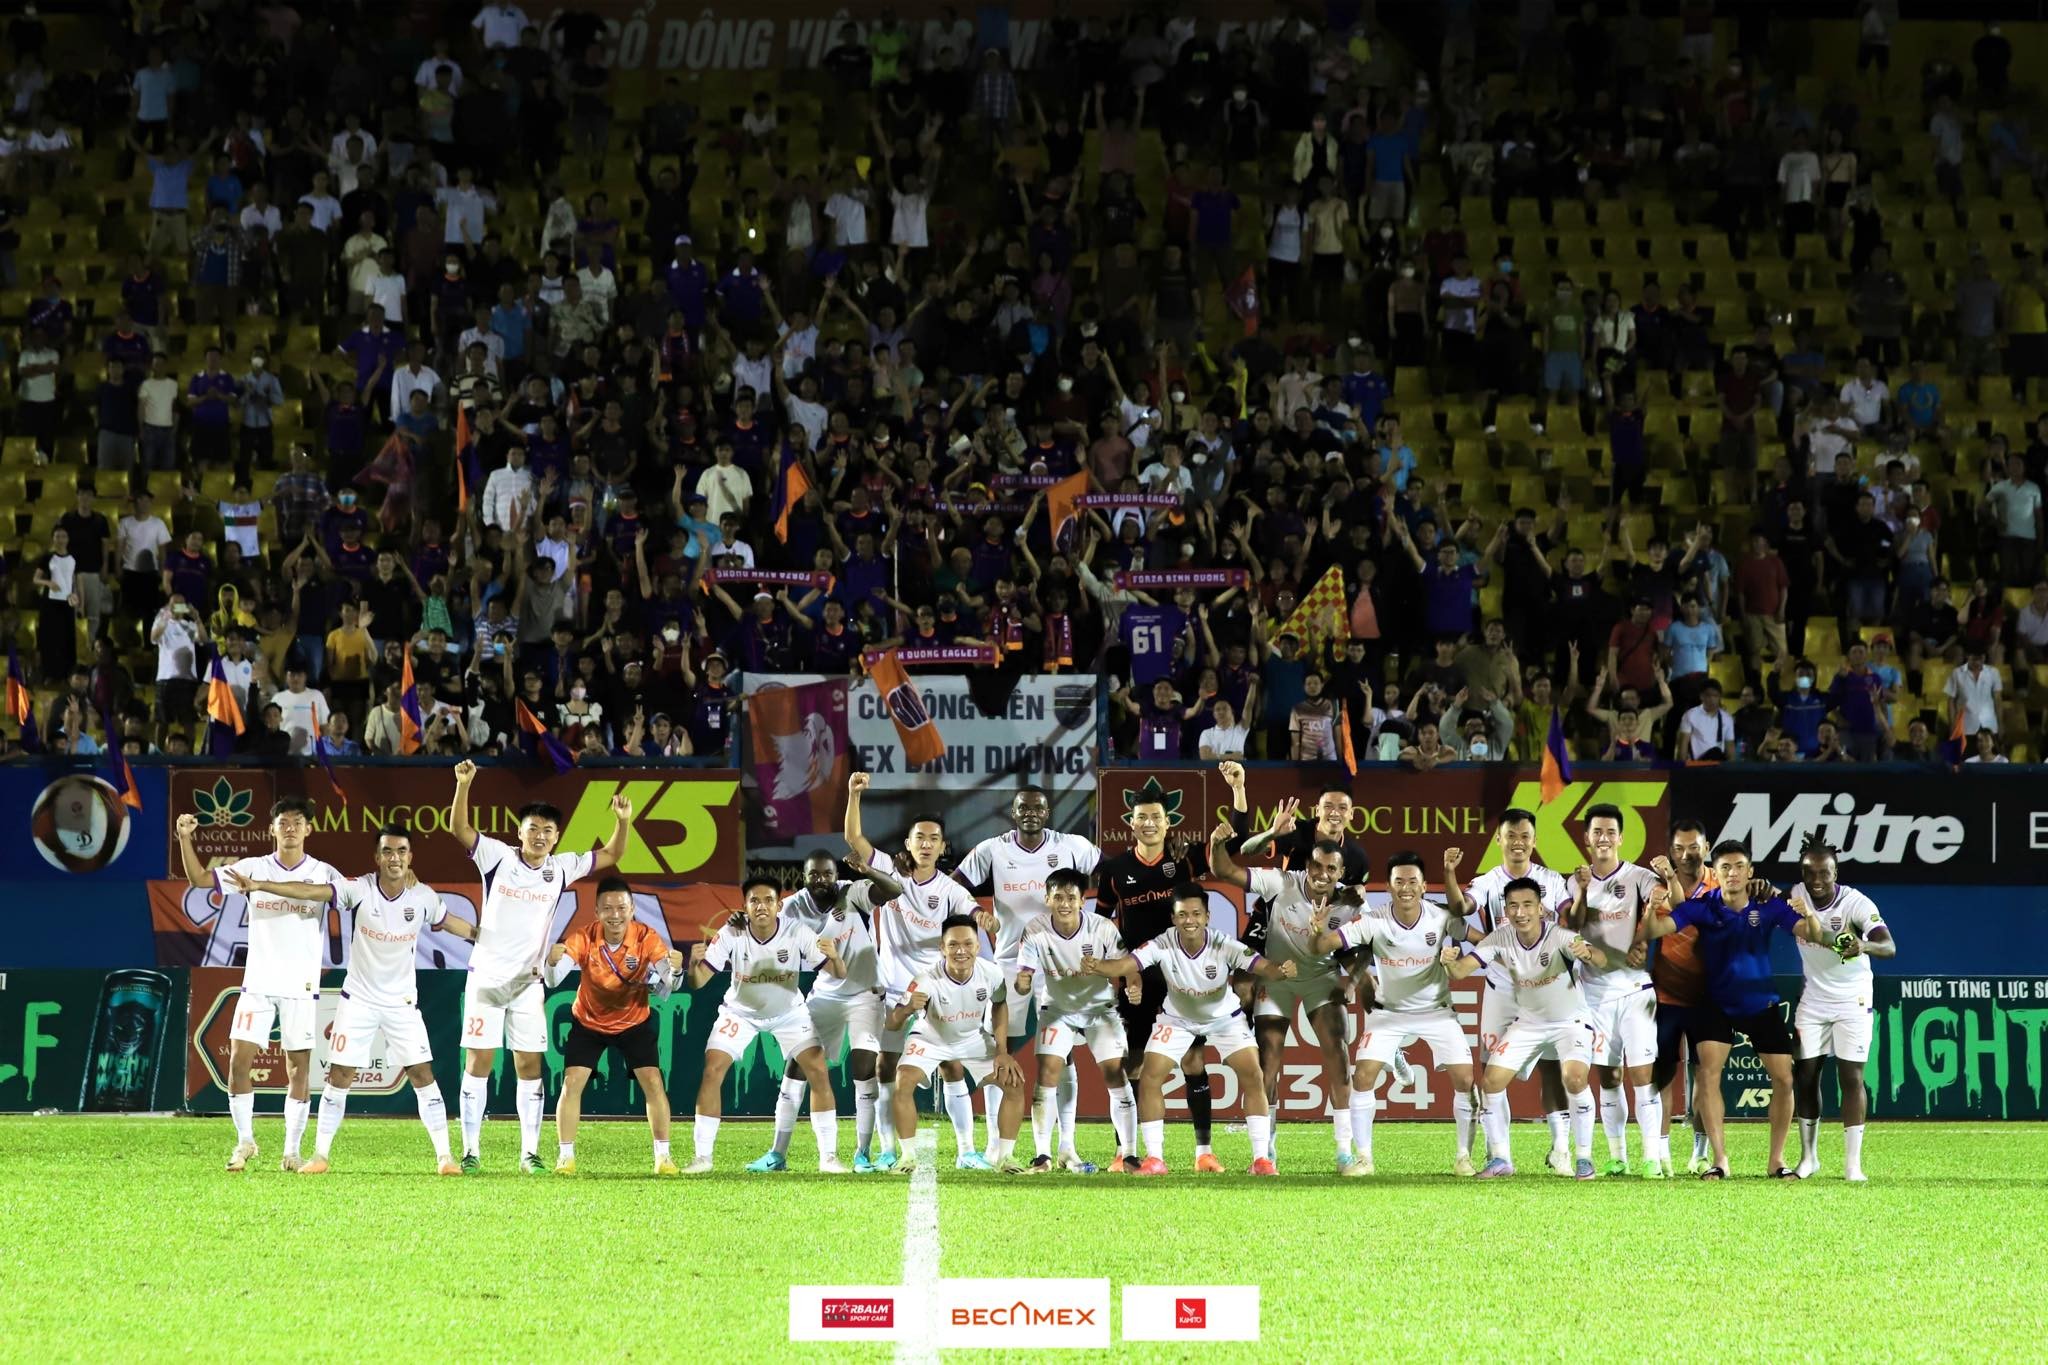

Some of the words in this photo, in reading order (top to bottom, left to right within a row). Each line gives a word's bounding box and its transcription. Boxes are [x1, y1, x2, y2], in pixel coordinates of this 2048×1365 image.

[1132, 574, 1163, 584] FORZA
[1166, 573, 1191, 583] BINH
[1193, 572, 1226, 582] DUONG
[1132, 625, 1162, 654] 61
[907, 649, 939, 659] DUONG
[942, 647, 979, 658] EAGLES
[473, 804, 523, 833] LIN
[554, 780, 739, 874] K5
[1403, 806, 1486, 835] LINH
[1705, 792, 1965, 864] Mitre
[173, 831, 199, 842] SM
[197, 845, 248, 853] KONTUM
[1901, 978, 1942, 998] NƯỚC
[1947, 979, 1991, 998] TĂNG
[1998, 979, 2029, 1001] LỰC
[237, 1010, 253, 1031] 11
[467, 1017, 484, 1037] 32
[719, 1018, 739, 1038] 29
[330, 1032, 347, 1053] 10
[1041, 1026, 1058, 1046] 17
[1152, 1023, 1172, 1044] 28
[906, 1043, 925, 1057] 34
[1729, 1056, 1764, 1072] NGỌ
[1727, 1073, 1772, 1081] KONTU
[1736, 1088, 1774, 1108] K5
